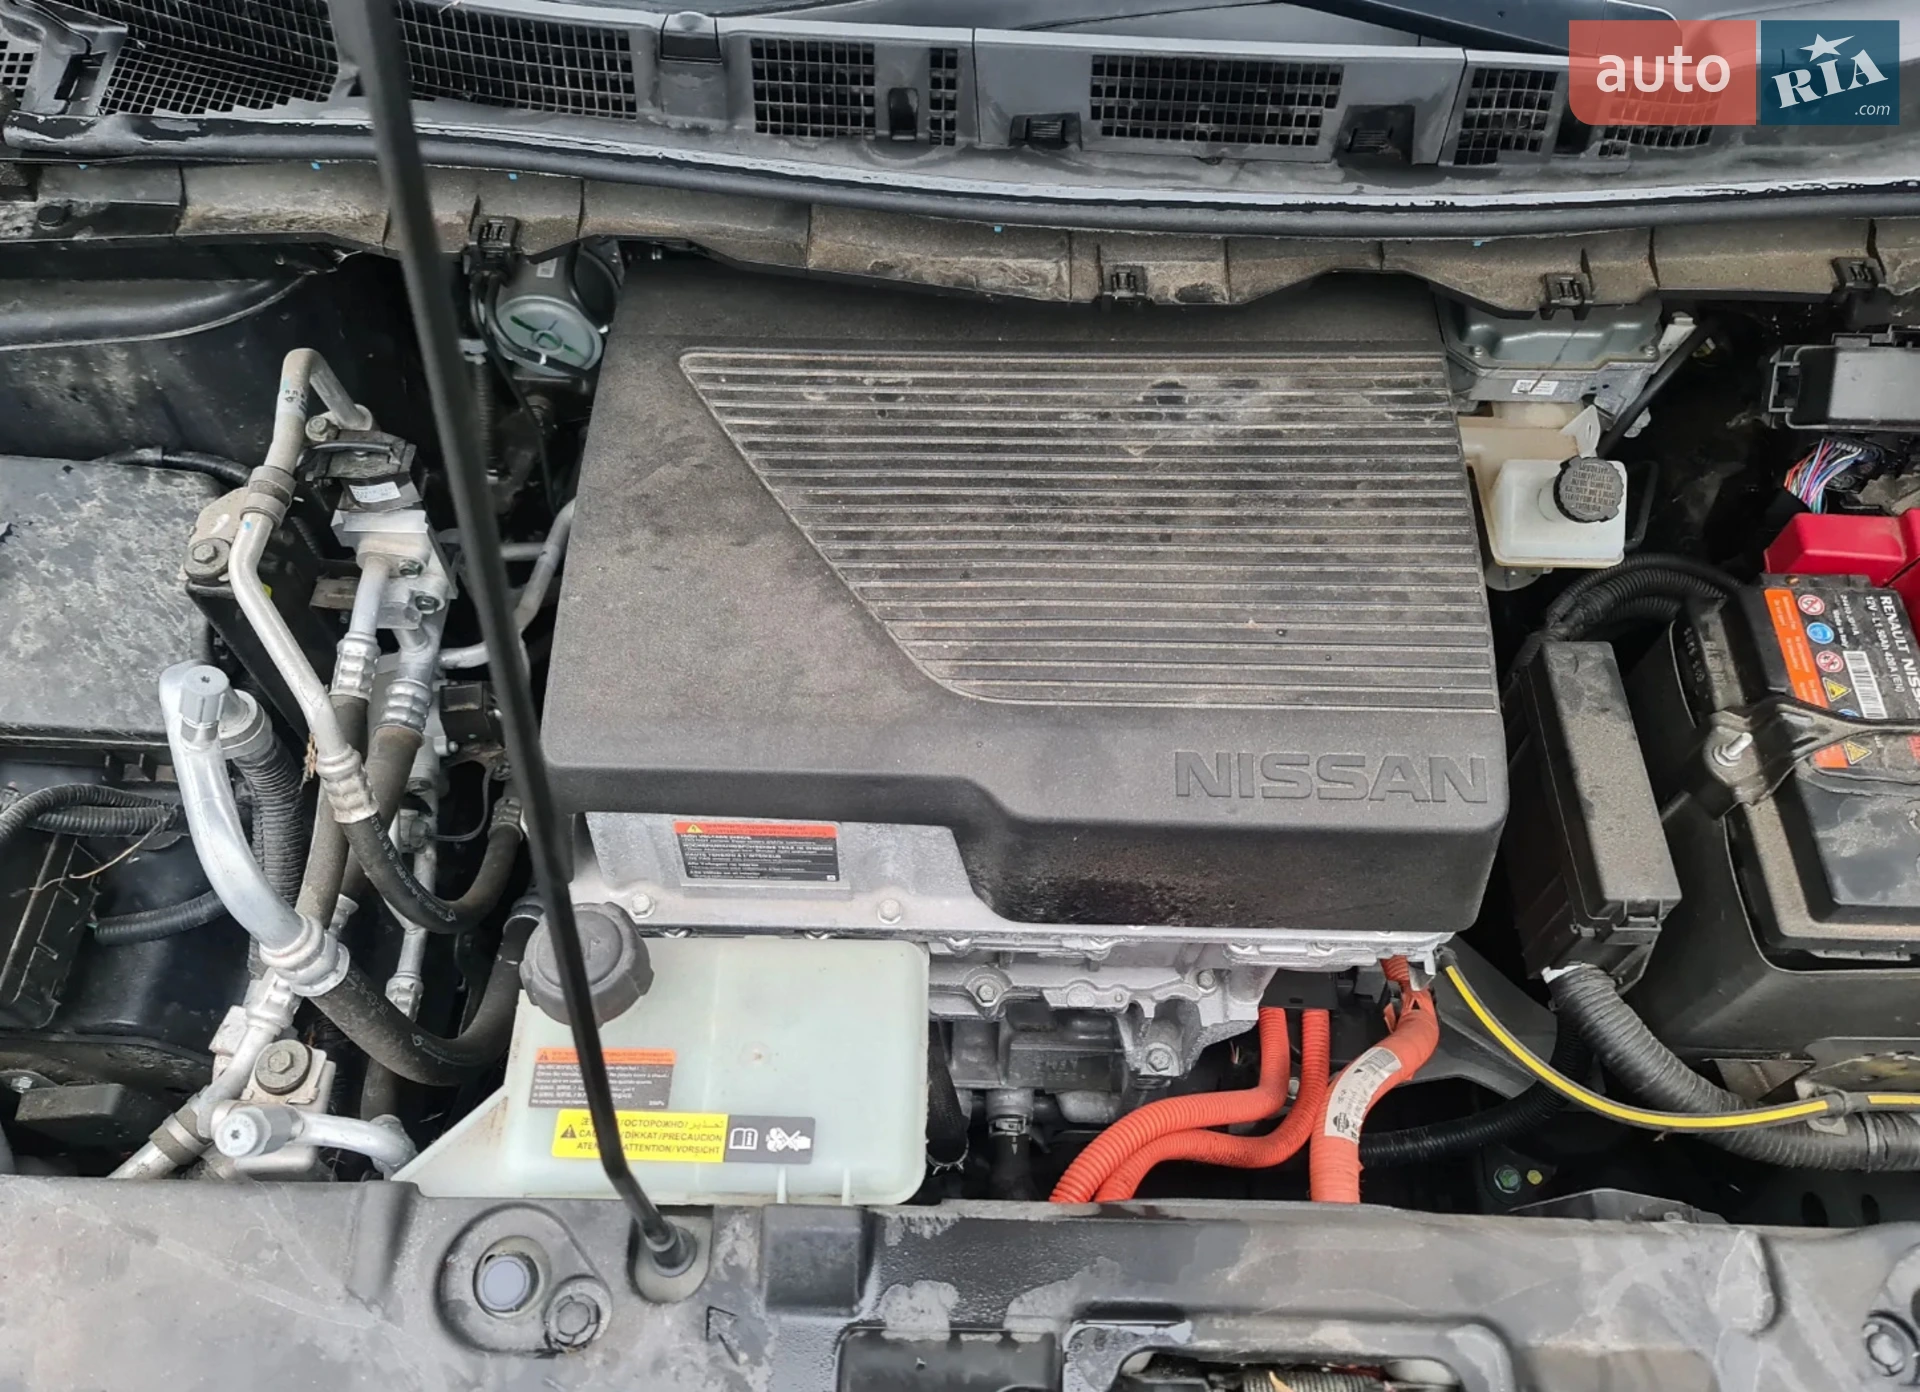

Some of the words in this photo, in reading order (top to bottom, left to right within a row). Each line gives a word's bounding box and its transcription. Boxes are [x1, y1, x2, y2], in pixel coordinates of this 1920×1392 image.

[1864, 595, 1878, 611] 12V
[1876, 629, 1890, 651] 50Ah
[1884, 651, 1898, 673] 420A
[1880, 595, 1911, 654] RENAULT
[1175, 751, 1488, 804] NISSAN
